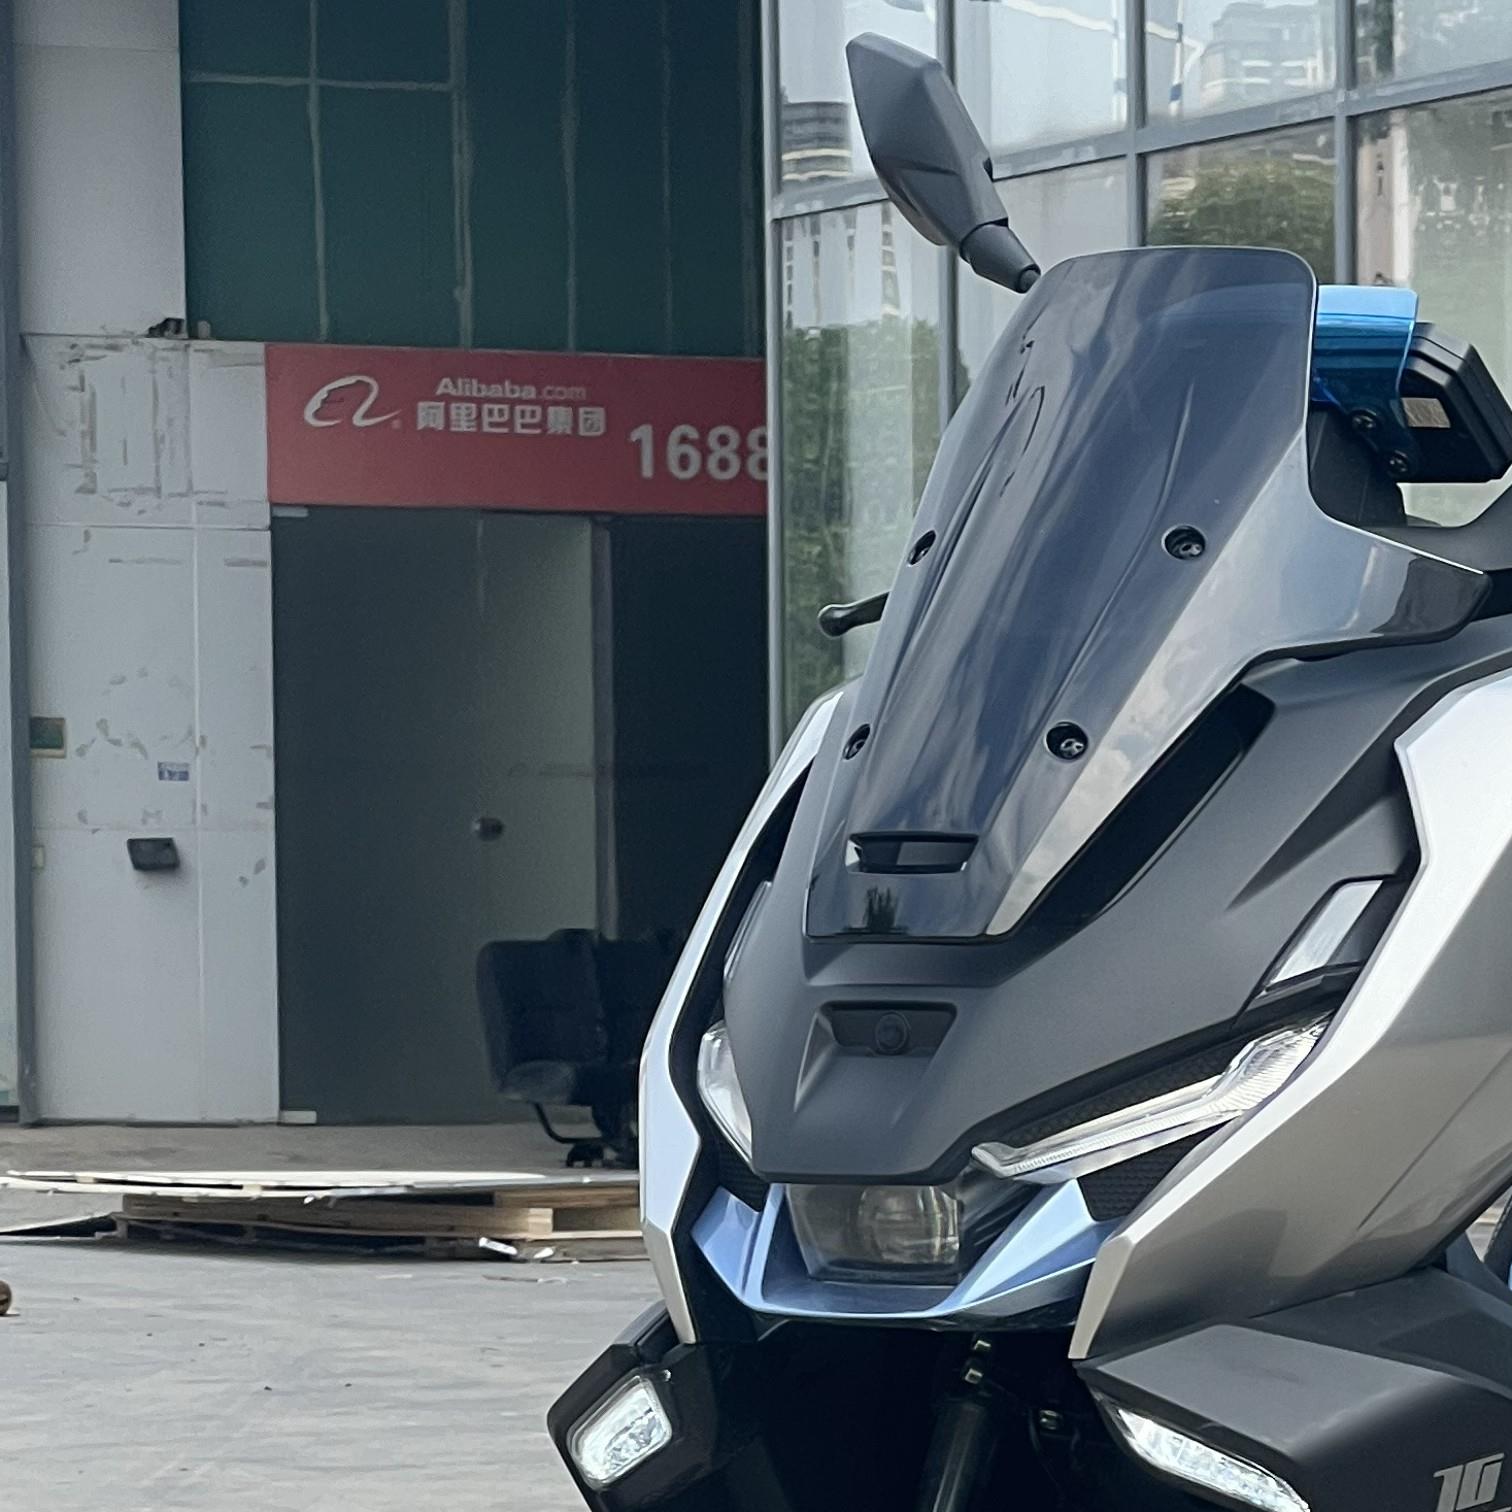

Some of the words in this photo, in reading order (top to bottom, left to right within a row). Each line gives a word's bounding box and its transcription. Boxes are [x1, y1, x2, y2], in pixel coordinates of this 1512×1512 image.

[435, 377, 587, 400] Alibaba.com
[416, 401, 606, 437] 阿里巴巴集团
